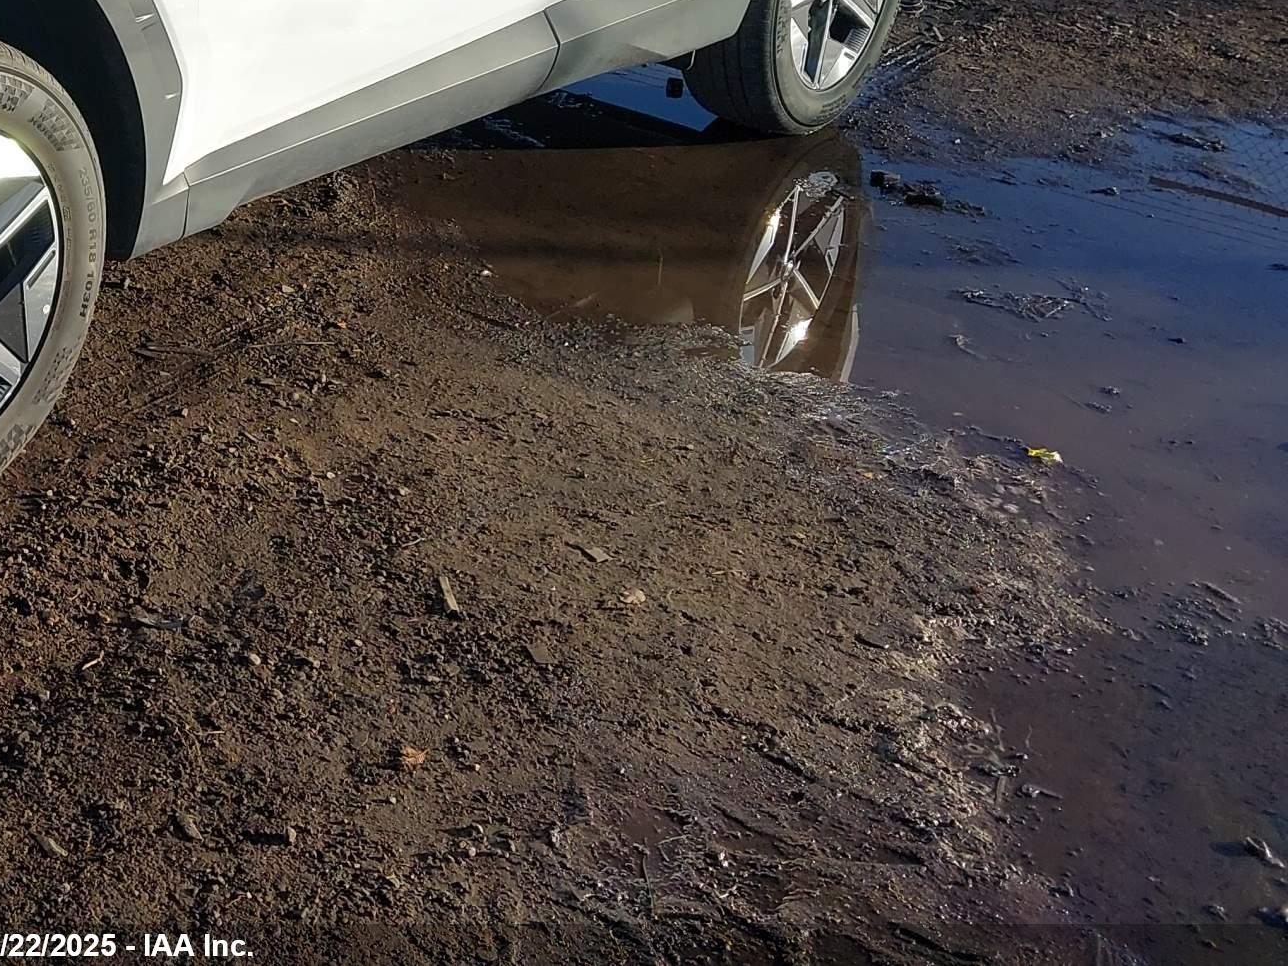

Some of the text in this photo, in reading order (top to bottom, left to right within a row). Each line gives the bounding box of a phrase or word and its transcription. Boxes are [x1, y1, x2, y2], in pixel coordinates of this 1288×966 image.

[78, 166, 97, 318] 235/60 R18 103H
